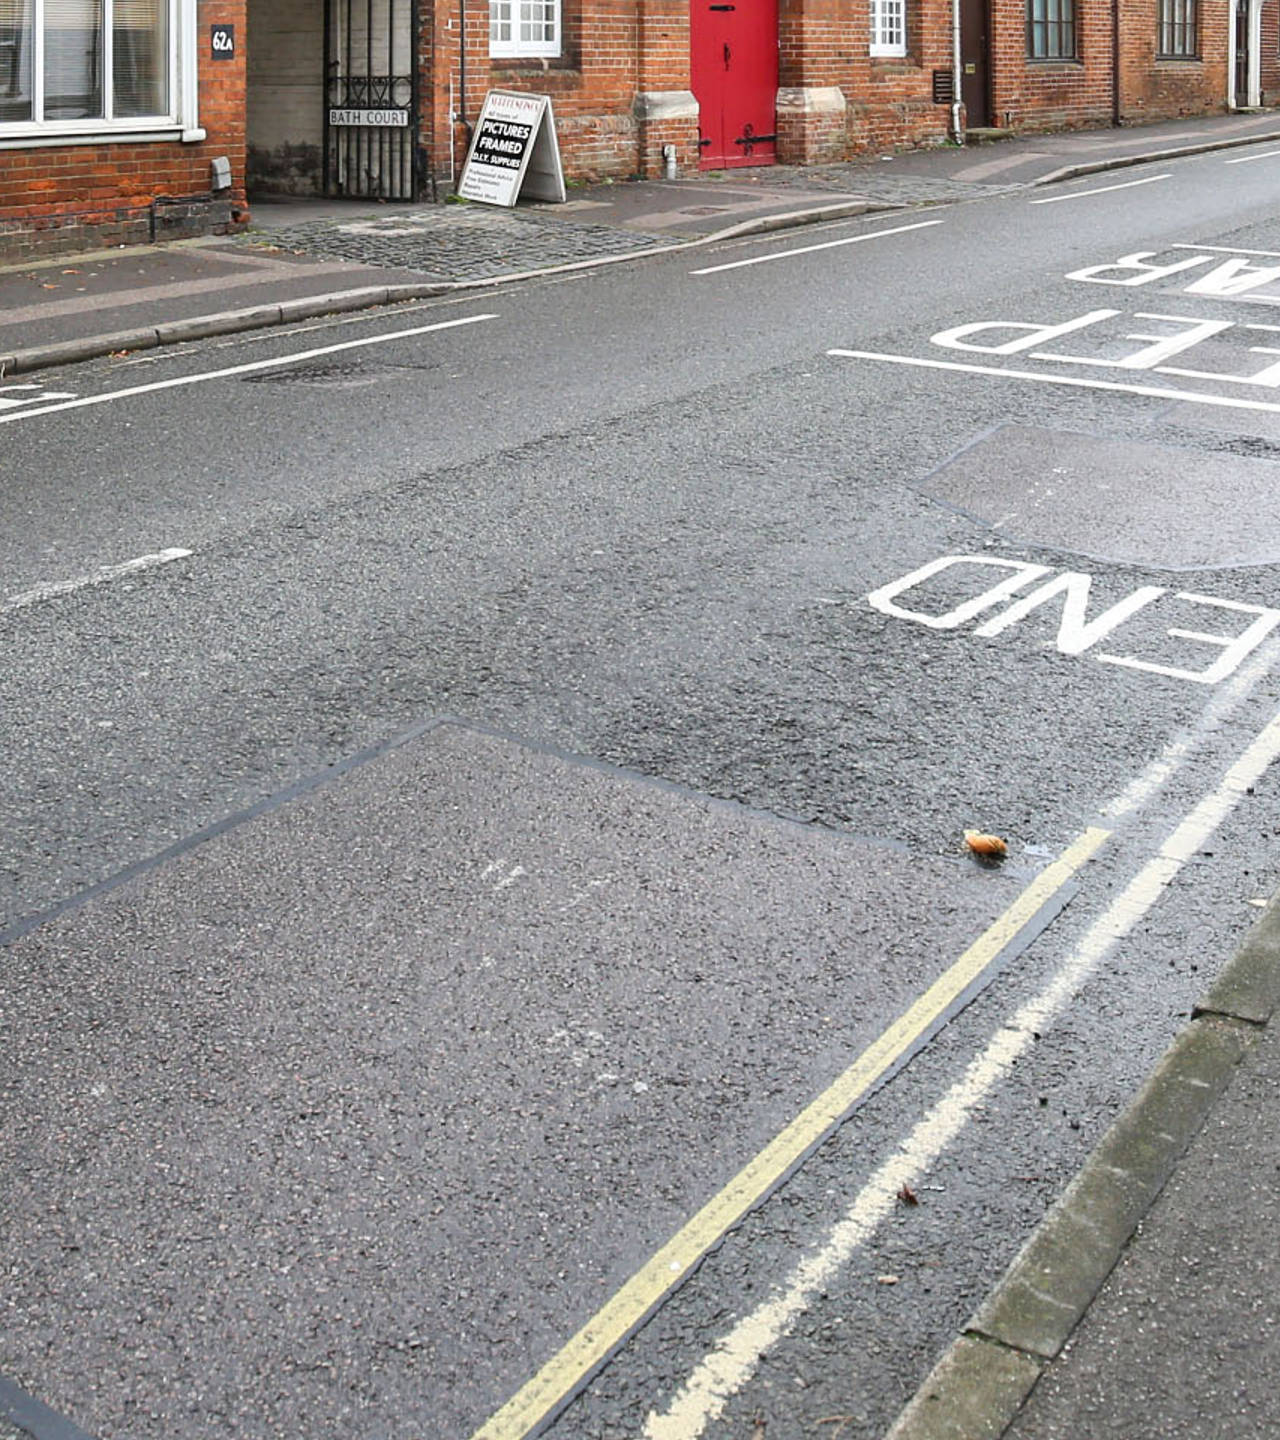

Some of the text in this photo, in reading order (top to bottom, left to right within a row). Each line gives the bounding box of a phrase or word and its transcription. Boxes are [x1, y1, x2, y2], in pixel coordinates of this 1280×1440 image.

[212, 31, 234, 51] 62A
[330, 110, 406, 125] BATH COURT
[483, 122, 529, 139] PICTURES
[479, 137, 522, 153] FRAMED
[471, 152, 521, 168] D.I.Y. SUPPLIES
